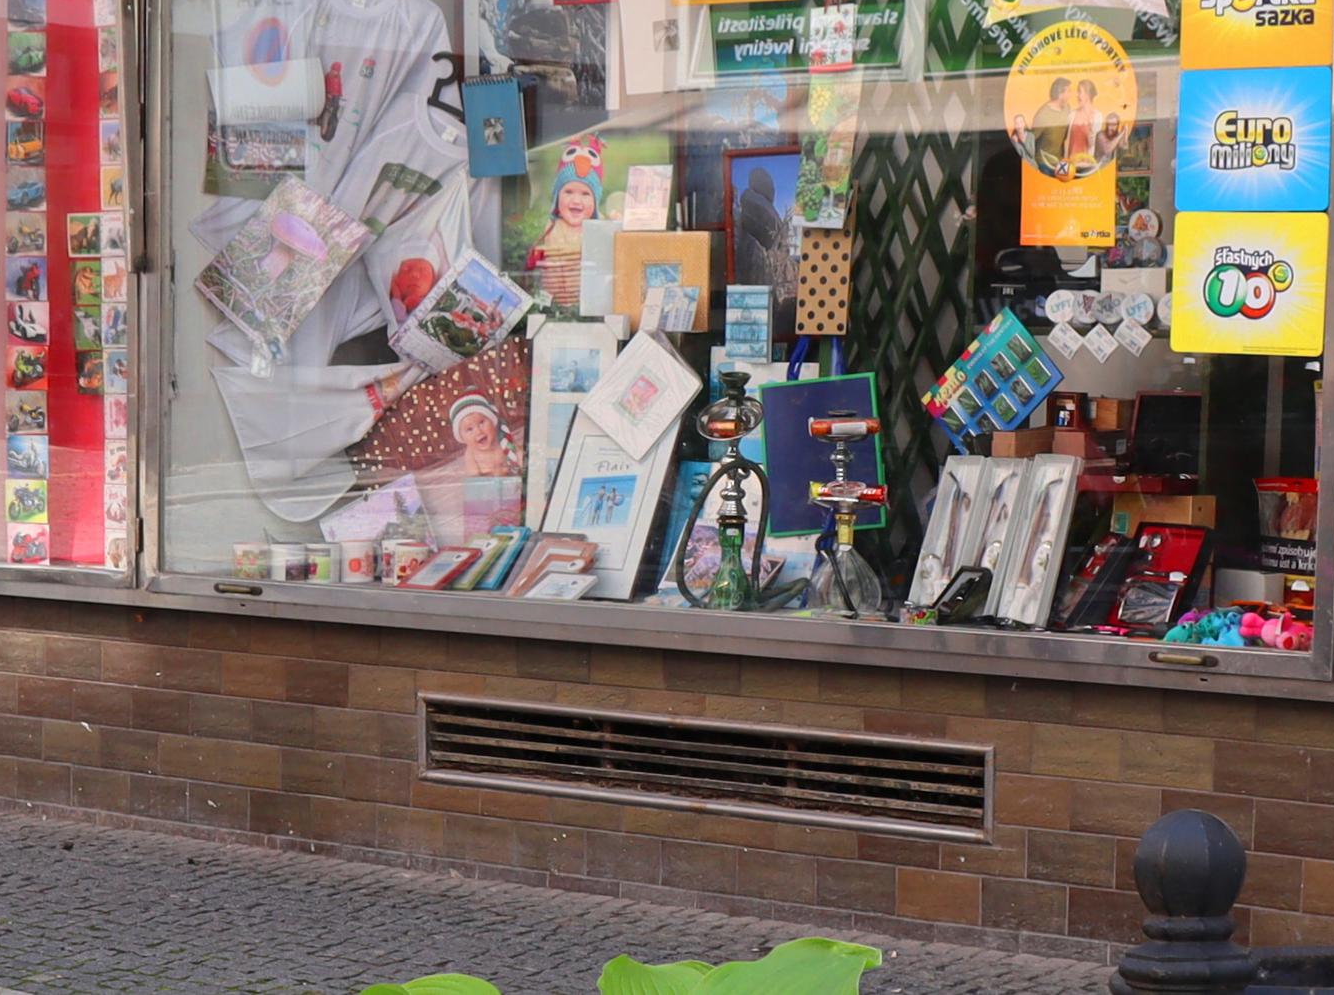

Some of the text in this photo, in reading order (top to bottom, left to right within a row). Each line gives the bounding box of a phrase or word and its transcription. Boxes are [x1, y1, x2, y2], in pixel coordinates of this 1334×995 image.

[1064, 24, 1089, 40] LÉTO
[1213, 110, 1293, 147] Euro
[1208, 140, 1298, 172] miliony
